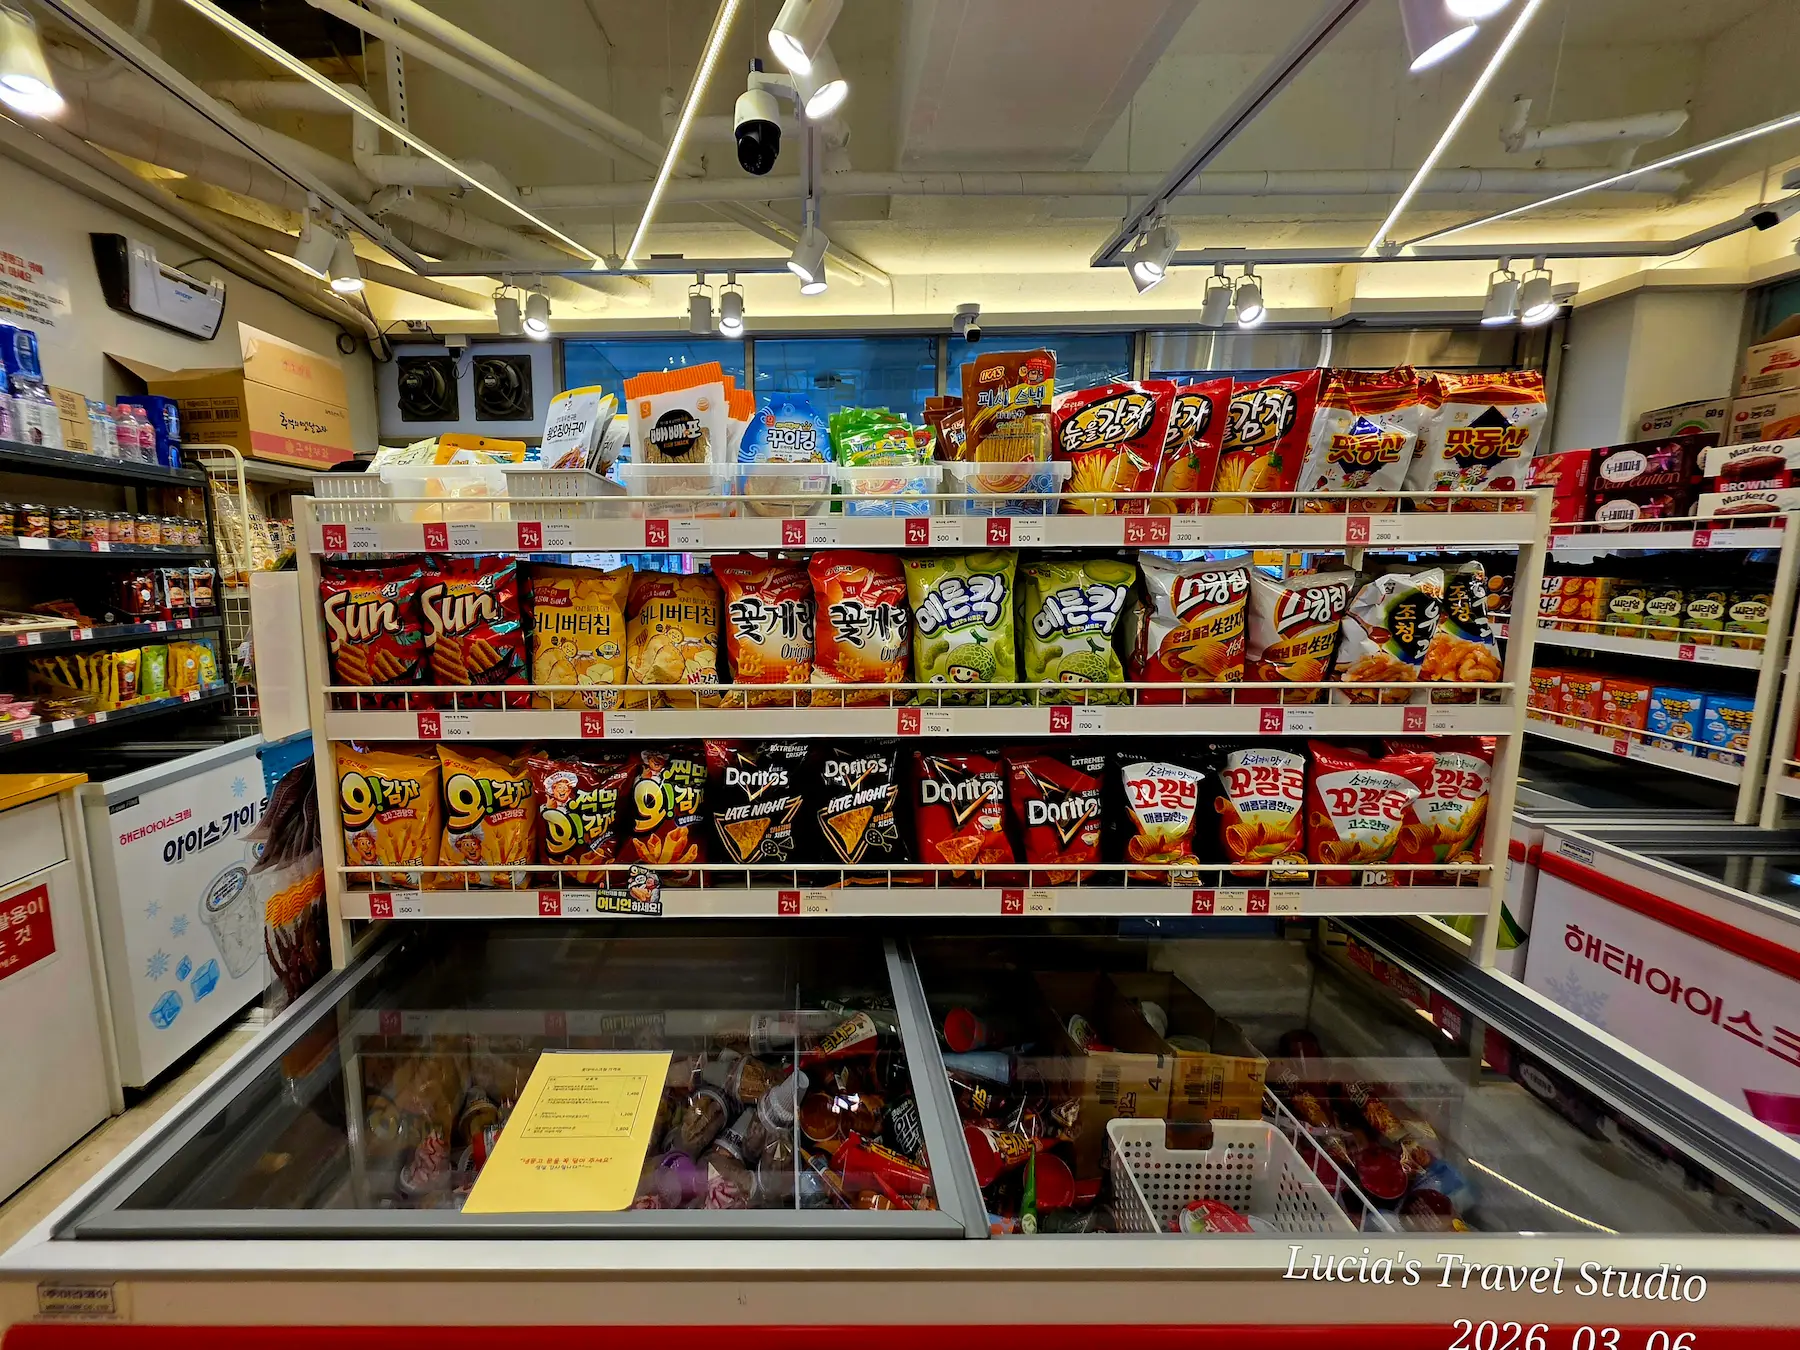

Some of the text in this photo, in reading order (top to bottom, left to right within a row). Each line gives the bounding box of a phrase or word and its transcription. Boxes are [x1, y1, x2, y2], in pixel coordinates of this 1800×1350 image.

[766, 428, 817, 451] 꾸이킹
[1442, 427, 1530, 460] 맛동산
[1728, 444, 1770, 459] Market
[1720, 479, 1783, 492] BROWNIE
[1722, 492, 1765, 505] Market
[428, 534, 446, 547] 24
[521, 531, 540, 546] 24
[649, 530, 666, 544] 24
[785, 529, 803, 543] 24
[909, 529, 927, 542] 24
[989, 528, 1008, 543] 24
[1127, 527, 1146, 541] 24
[1150, 526, 1167, 541] 24
[1348, 526, 1367, 540] 24
[326, 535, 344, 548] 24
[914, 575, 1004, 636] 메론킥
[1032, 585, 1127, 639] 메론킥
[1277, 585, 1348, 632] 스윙칩
[323, 590, 400, 653] Sun
[421, 583, 497, 647] Sun
[640, 602, 718, 627] 허니버터칩
[1394, 603, 1417, 644] 조청
[421, 723, 439, 736] 24
[584, 721, 601, 734] 24
[902, 717, 919, 732] 24
[1052, 716, 1070, 729] 24
[1262, 717, 1304, 731] 24 1600
[1406, 715, 1424, 729] 24
[825, 757, 888, 778] Doritos
[726, 767, 789, 787] Doritos
[827, 784, 889, 813] LATE NIGHT
[922, 780, 1003, 805] Doritos
[724, 803, 751, 821] LATE
[751, 796, 787, 817] NIGHT
[119, 807, 192, 846] 해태아이스크림
[373, 901, 389, 915] 24
[541, 899, 581, 913] 24 1600
[781, 899, 820, 913] 24 1600
[1005, 899, 1021, 911] 24
[1196, 899, 1212, 912] 24
[1250, 900, 1267, 911] 24
[14, 924, 33, 947] 것
